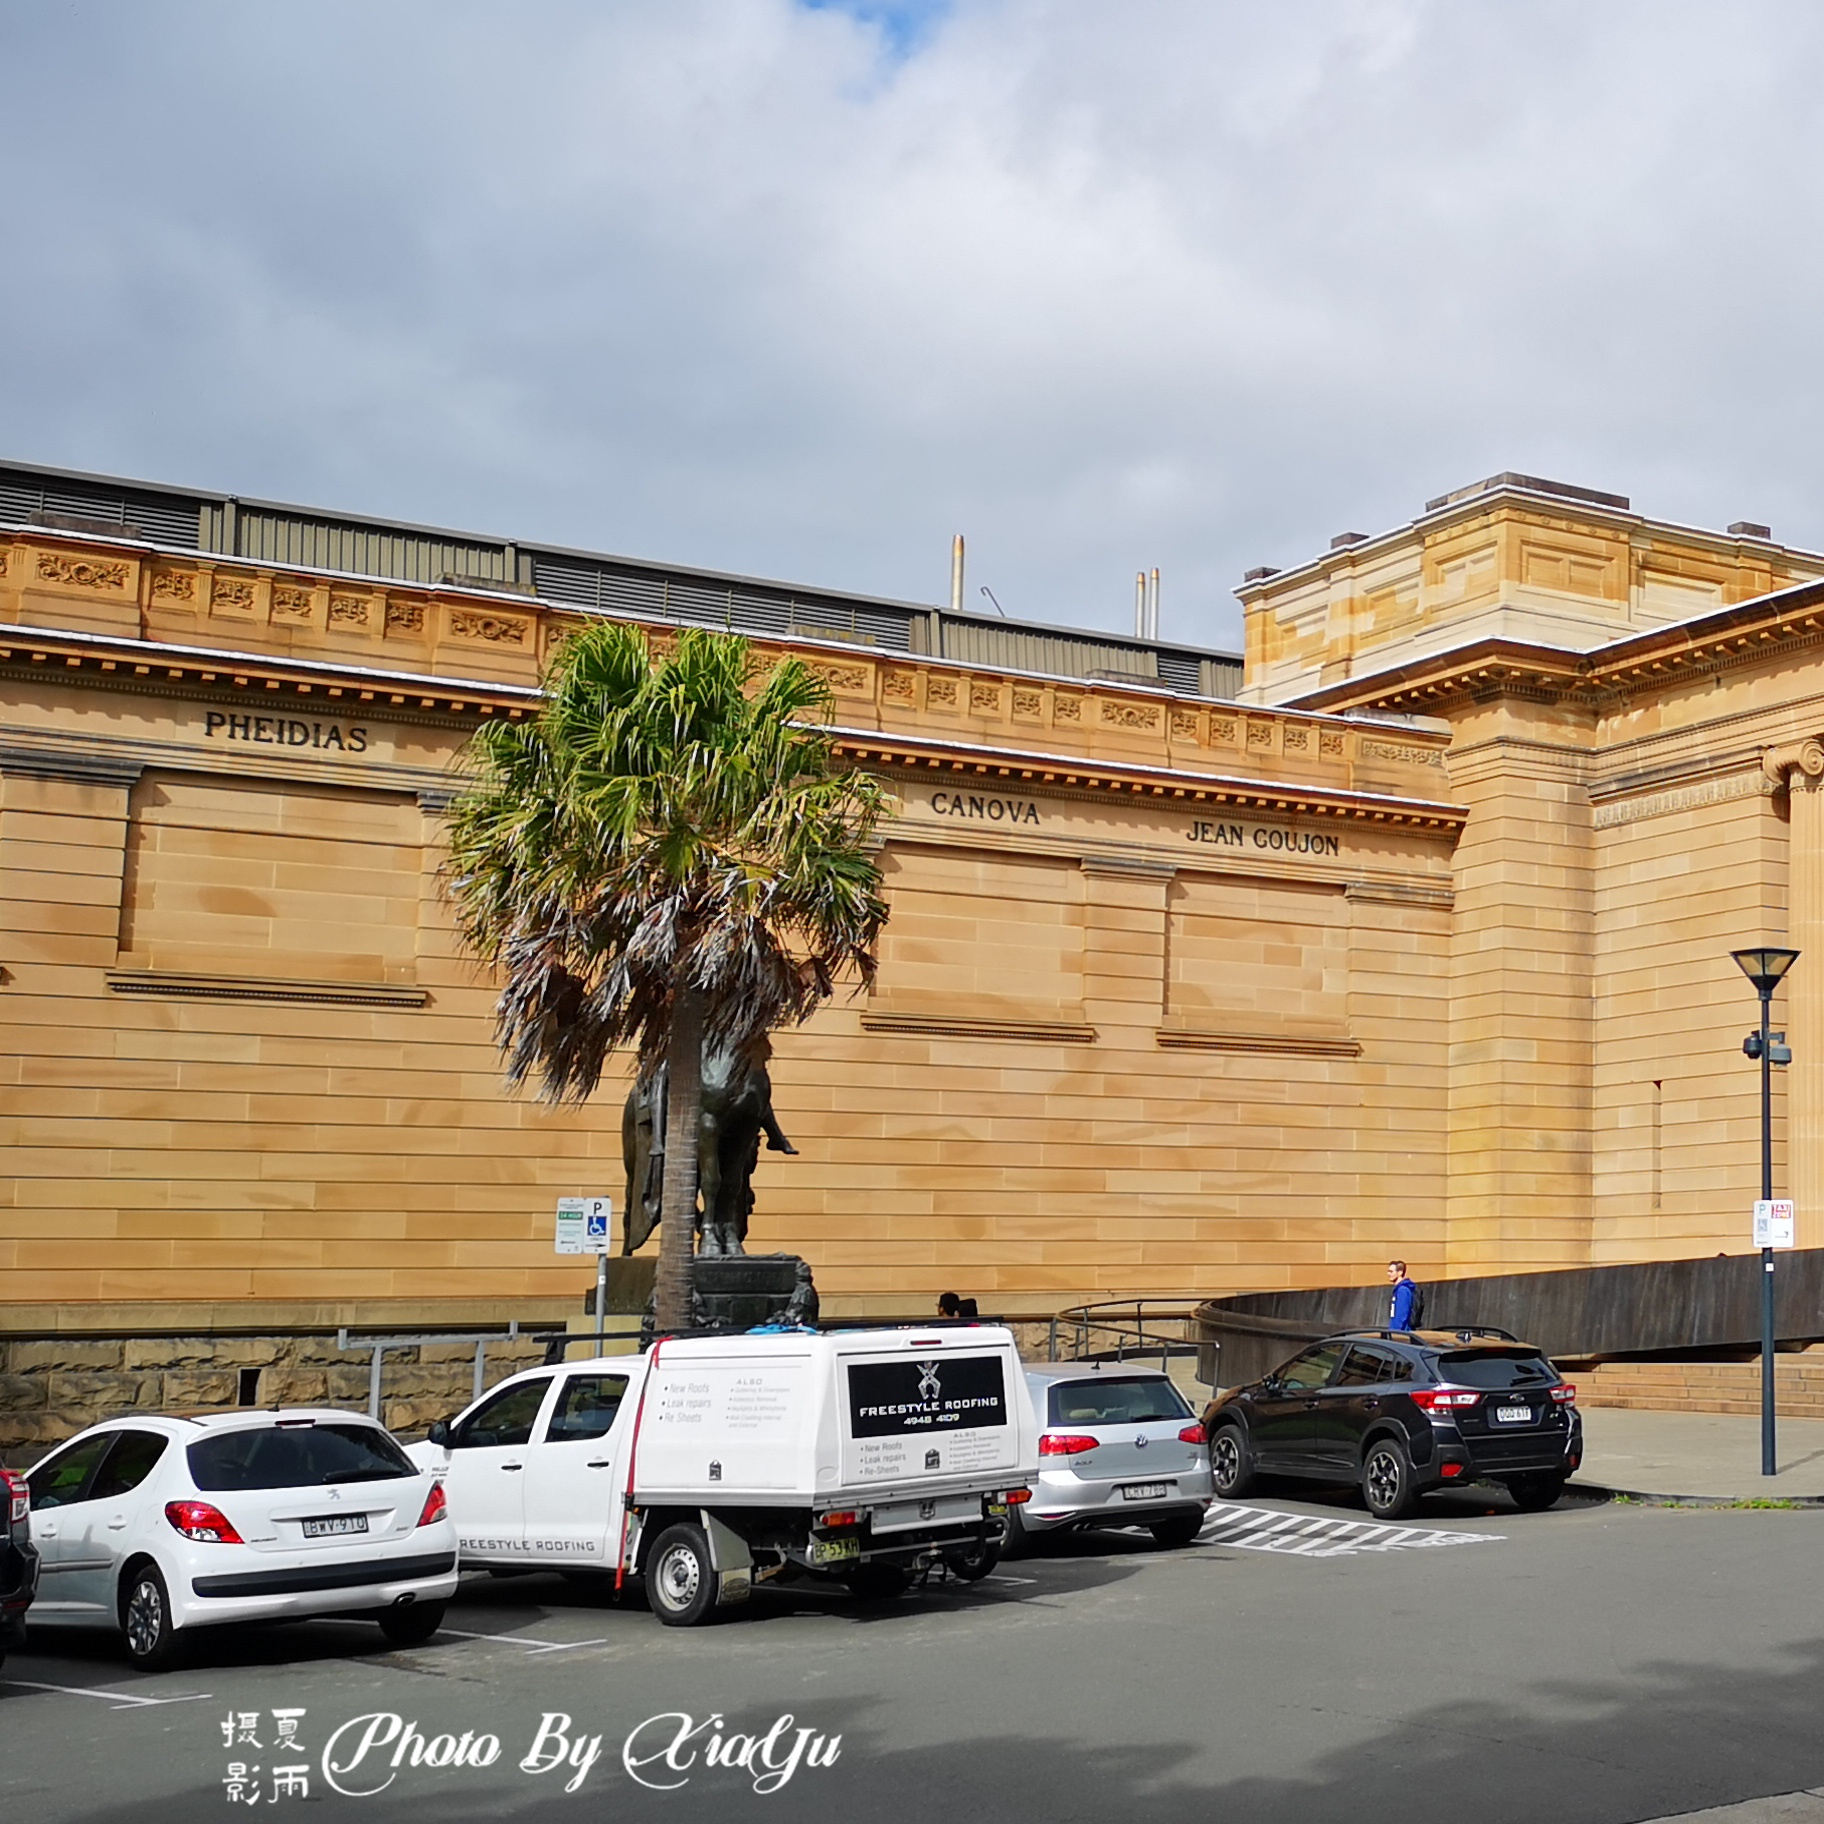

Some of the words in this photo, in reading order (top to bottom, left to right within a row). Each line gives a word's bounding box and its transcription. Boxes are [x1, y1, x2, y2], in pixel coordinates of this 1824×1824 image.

[204, 710, 368, 753] PHEIDIAS
[931, 792, 1041, 826] CANOVA
[1186, 820, 1245, 848] JEAN
[1252, 827, 1340, 858] GOUJON
[593, 1202, 603, 1214] P
[859, 1401, 941, 1418] FREESTYLE
[944, 1396, 999, 1410] ROOFING
[458, 1538, 530, 1551] REESTYLE
[535, 1540, 596, 1552] ROOFING
